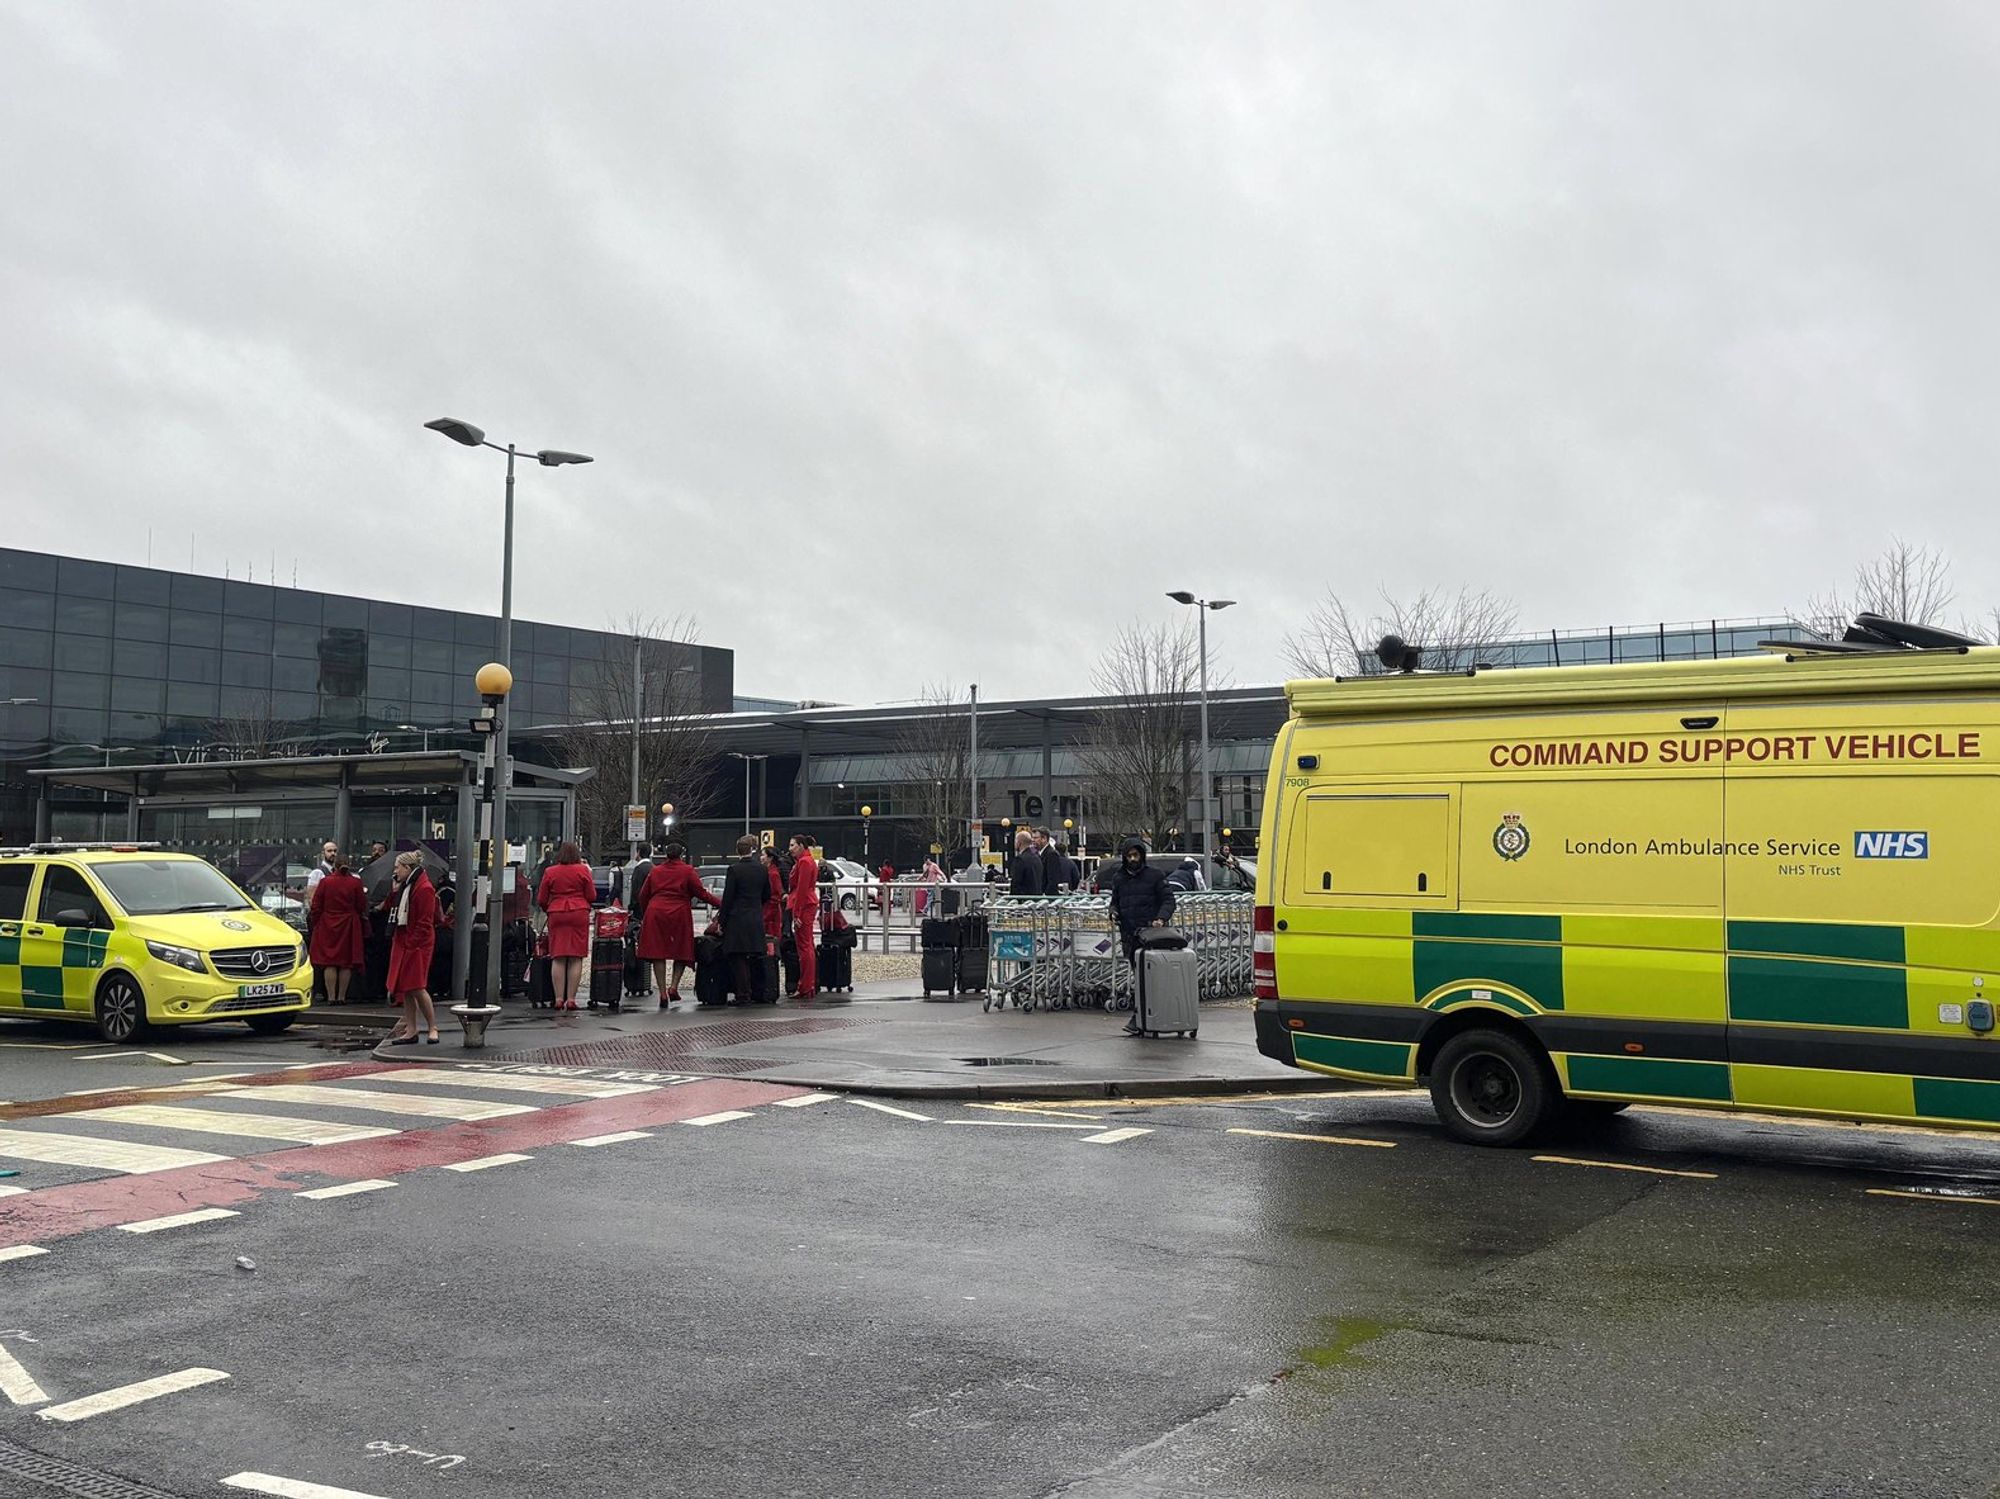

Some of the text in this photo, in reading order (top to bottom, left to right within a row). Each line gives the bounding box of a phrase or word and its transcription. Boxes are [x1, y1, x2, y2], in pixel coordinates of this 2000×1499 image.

[1489, 732, 1981, 768] COMMAND SUPPORT VEHICLE
[1285, 778, 1310, 787] 7908
[1565, 838, 1841, 856] London Ambulance Service
[1855, 832, 1926, 857] NHS
[1778, 864, 1841, 876] NHS Trust
